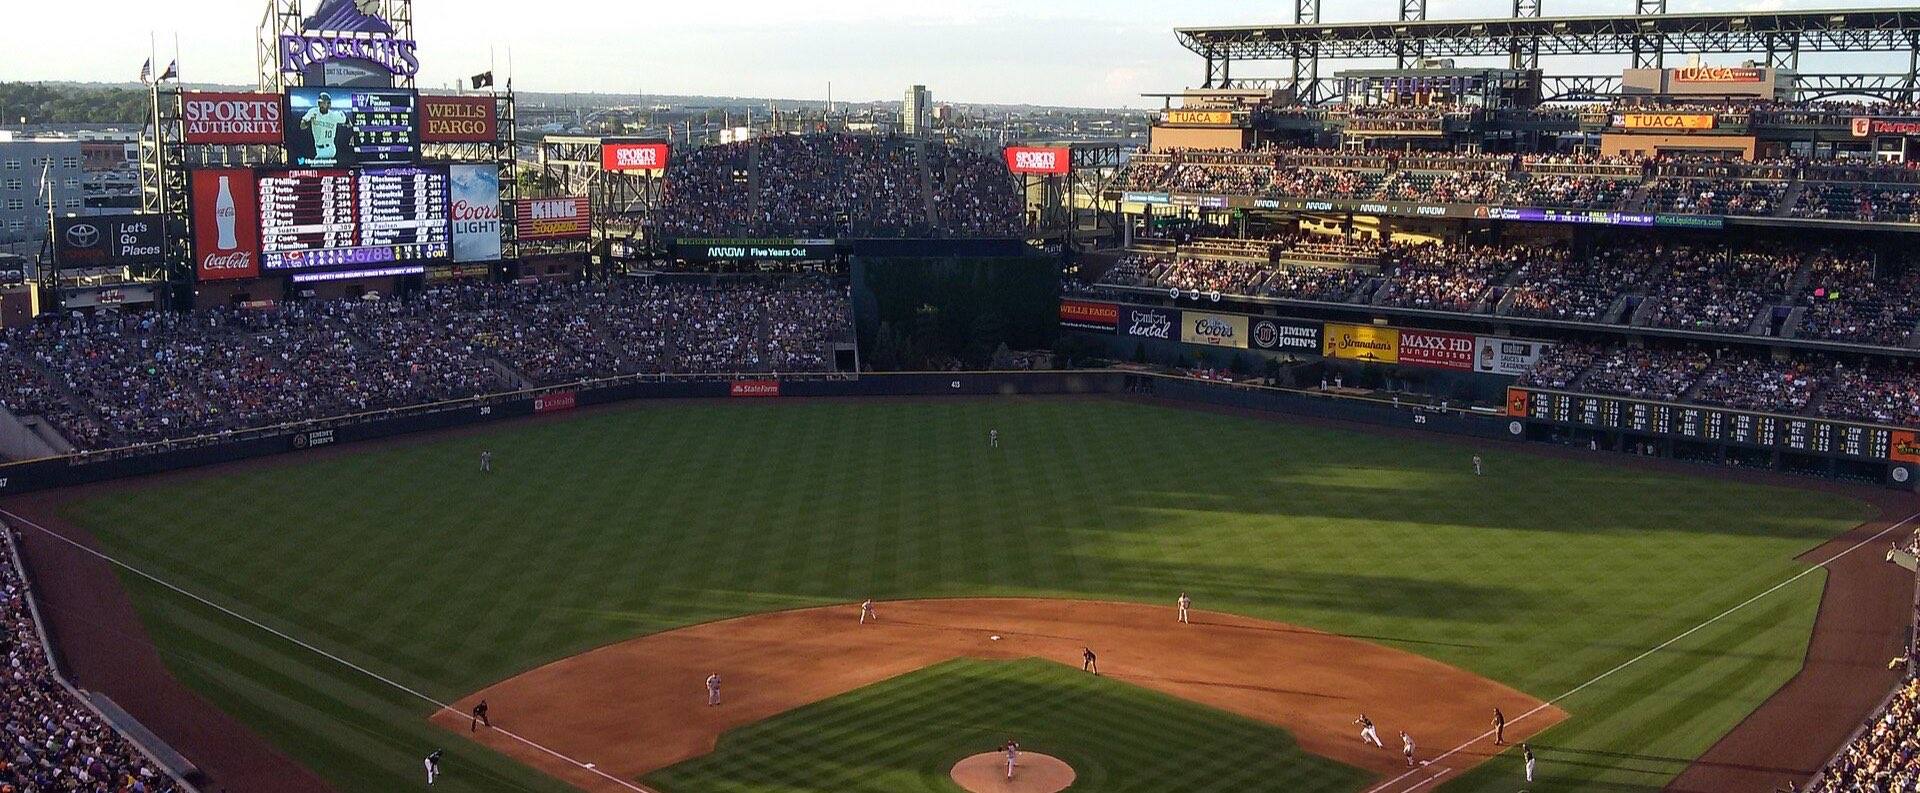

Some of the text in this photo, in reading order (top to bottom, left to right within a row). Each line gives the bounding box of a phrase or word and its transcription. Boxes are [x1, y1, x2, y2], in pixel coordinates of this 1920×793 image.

[280, 34, 419, 77] ROCKIES
[1678, 67, 1734, 82] TUACA
[186, 101, 279, 121] SPORTS
[426, 104, 486, 118] WELLS
[1176, 113, 1211, 122] TUACA
[1634, 116, 1684, 126] TUACA
[428, 120, 486, 134] FARGO
[325, 130, 332, 138] 10
[616, 148, 656, 160] SPORTS
[1016, 152, 1056, 161] SPORTS
[274, 178, 300, 186] Phillips
[532, 200, 577, 218] KING
[1254, 200, 1280, 208] ARROW
[1306, 201, 1332, 210] ARROW
[1360, 202, 1388, 212] ARROW
[452, 200, 499, 222] Coors
[1417, 206, 1446, 215] ARROW
[276, 218, 294, 227] Byrd
[1655, 215, 1722, 226] OfficeLiquidators.com
[120, 223, 148, 233] Let's
[456, 221, 496, 234] LIGHT
[120, 234, 136, 244] Go
[121, 245, 160, 256] Places
[708, 247, 806, 257] ARROW Five Years Out
[204, 251, 252, 270] Coca-Cola
[1060, 305, 1116, 317] WELLS FARGO
[1131, 309, 1167, 324] Comfort
[1128, 321, 1169, 338] dental
[1195, 318, 1233, 338] Coors
[1280, 326, 1317, 338] JIMMY
[1279, 337, 1317, 348] JOHN'S
[1339, 334, 1392, 351] Stranahan's
[1401, 334, 1472, 352] MAXX HD
[1400, 346, 1472, 360] sunglasses
[480, 406, 490, 415] 390
[1414, 415, 1426, 424] 375
